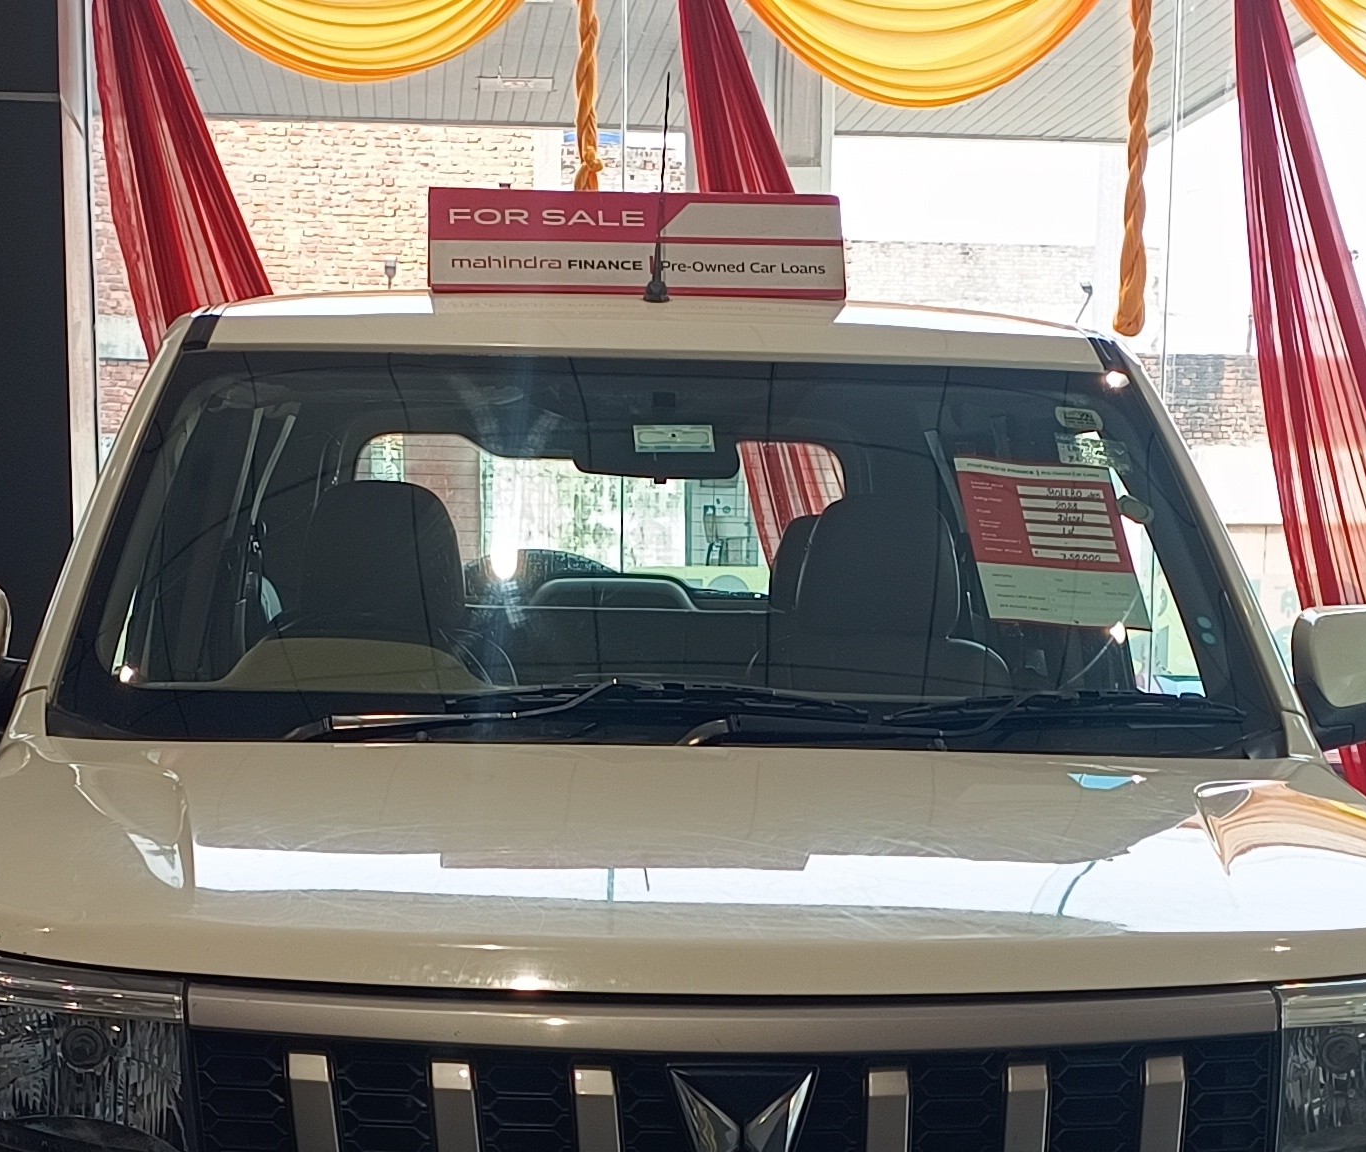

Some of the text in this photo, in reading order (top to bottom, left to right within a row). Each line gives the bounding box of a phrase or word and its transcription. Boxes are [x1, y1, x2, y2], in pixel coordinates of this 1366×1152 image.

[449, 208, 645, 227] FOR SALE
[451, 255, 826, 275] mahindra FINANCE Pre-Owned Car Loans
